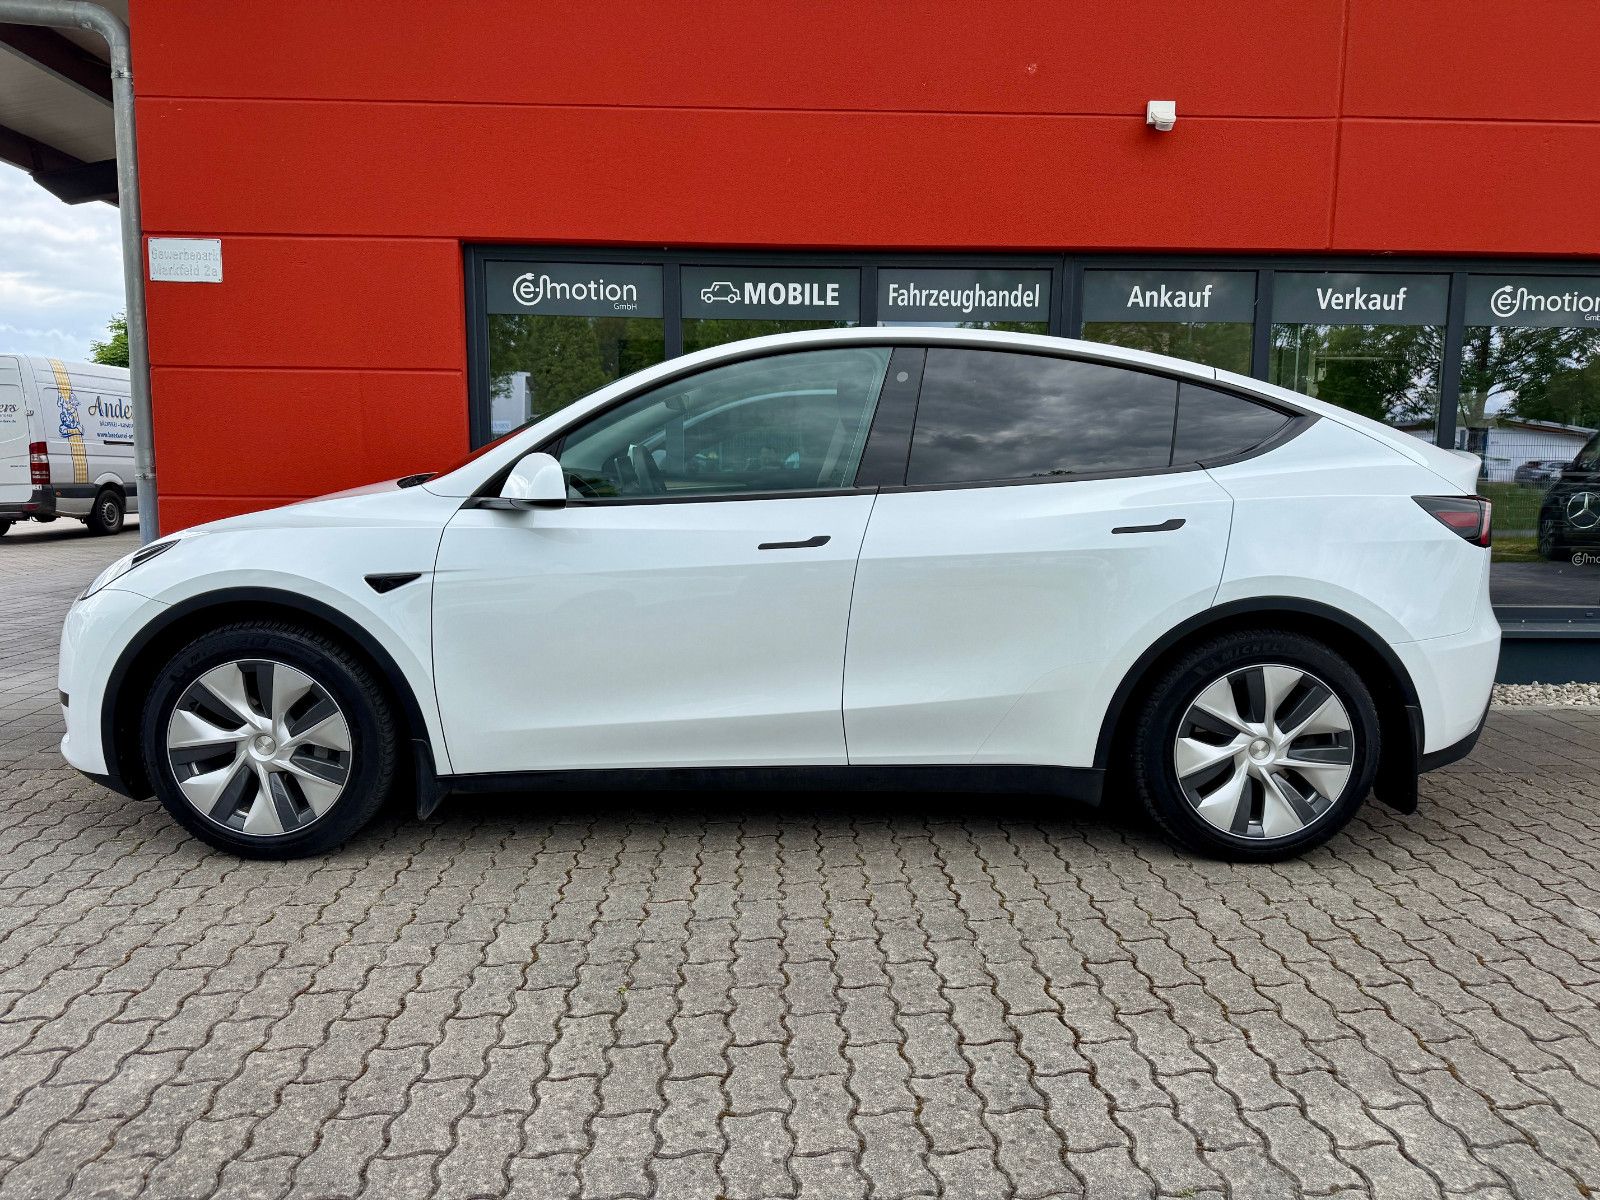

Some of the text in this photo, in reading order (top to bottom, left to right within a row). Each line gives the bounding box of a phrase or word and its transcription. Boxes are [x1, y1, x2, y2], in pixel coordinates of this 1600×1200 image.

[744, 282, 839, 305] MOBILE
[888, 282, 1040, 313] Fahrzeughandel
[1126, 284, 1213, 308] Ankauf
[1316, 286, 1408, 310] Verkauf
[613, 303, 638, 311] GmbH
[88, 396, 133, 419] Ande
